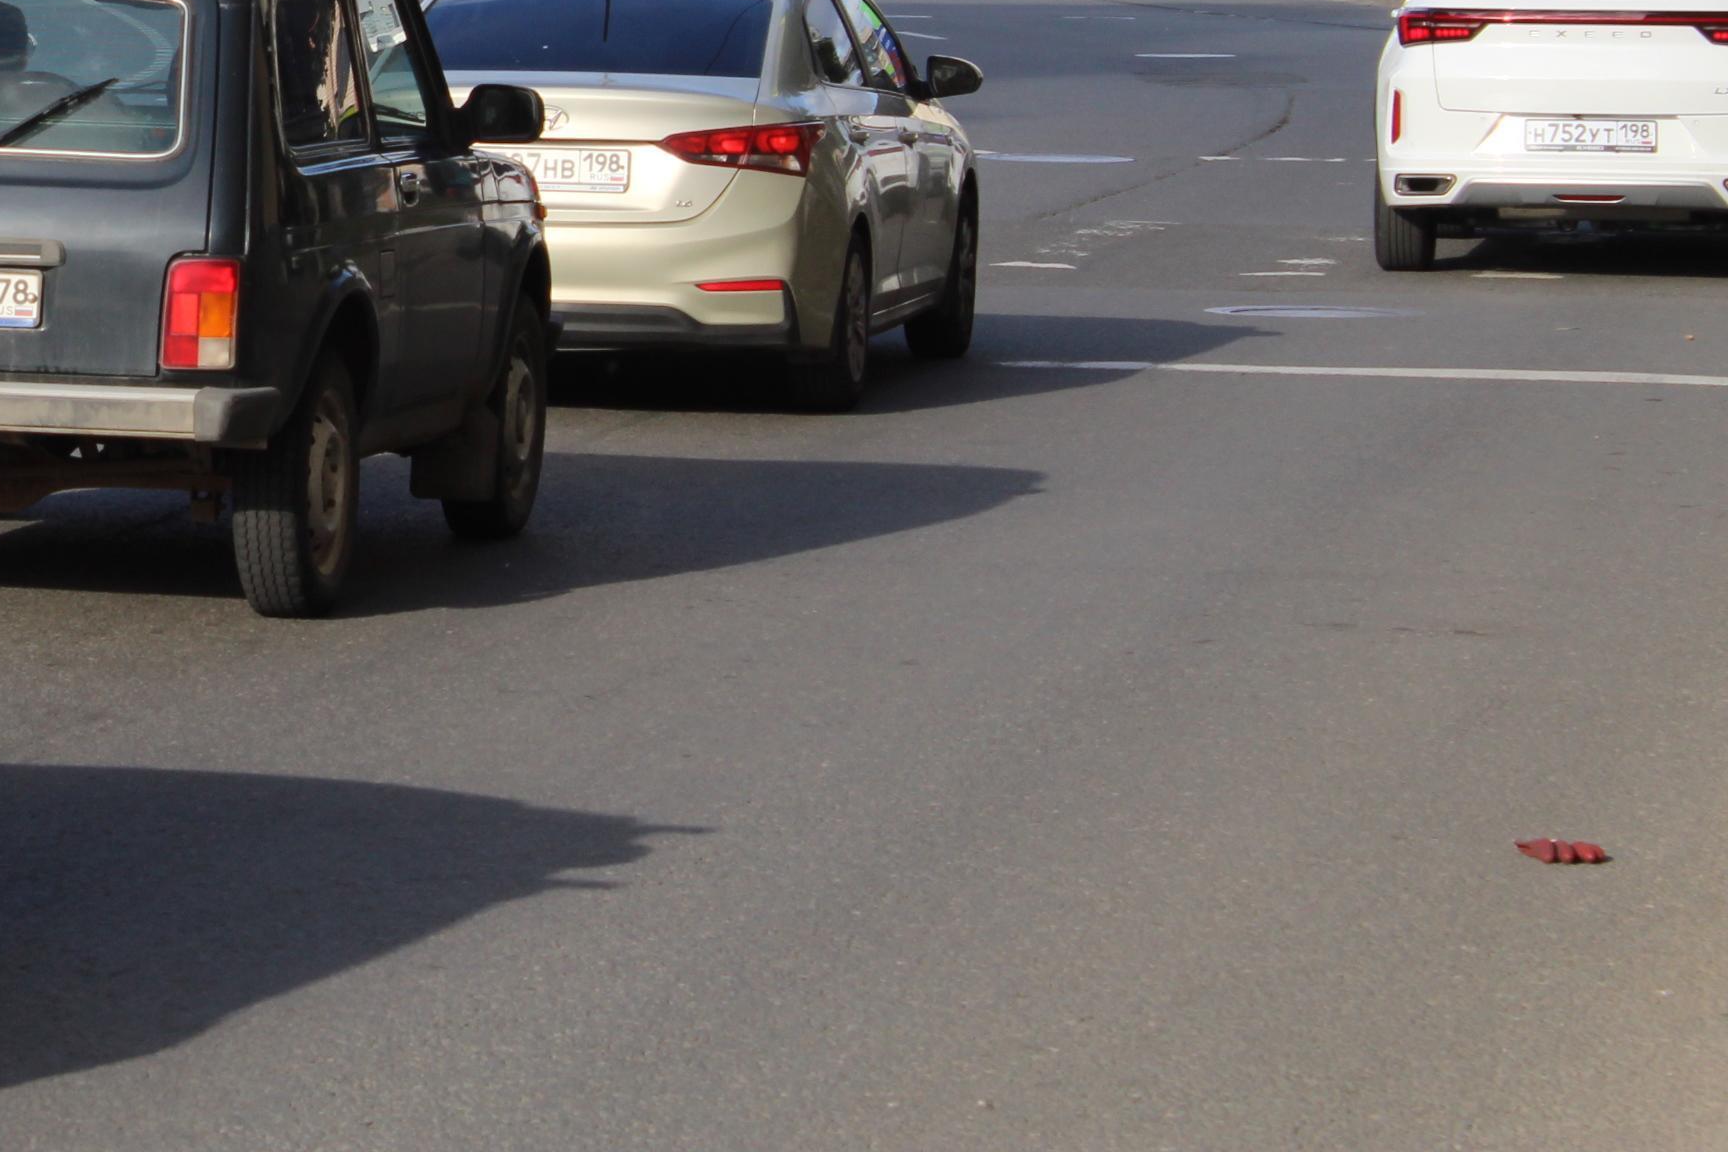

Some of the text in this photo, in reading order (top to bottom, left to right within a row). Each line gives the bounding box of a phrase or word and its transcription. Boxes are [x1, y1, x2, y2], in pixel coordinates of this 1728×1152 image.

[1529, 30, 1652, 39] EXEED
[1619, 123, 1650, 139] 198
[583, 152, 621, 173] 198
